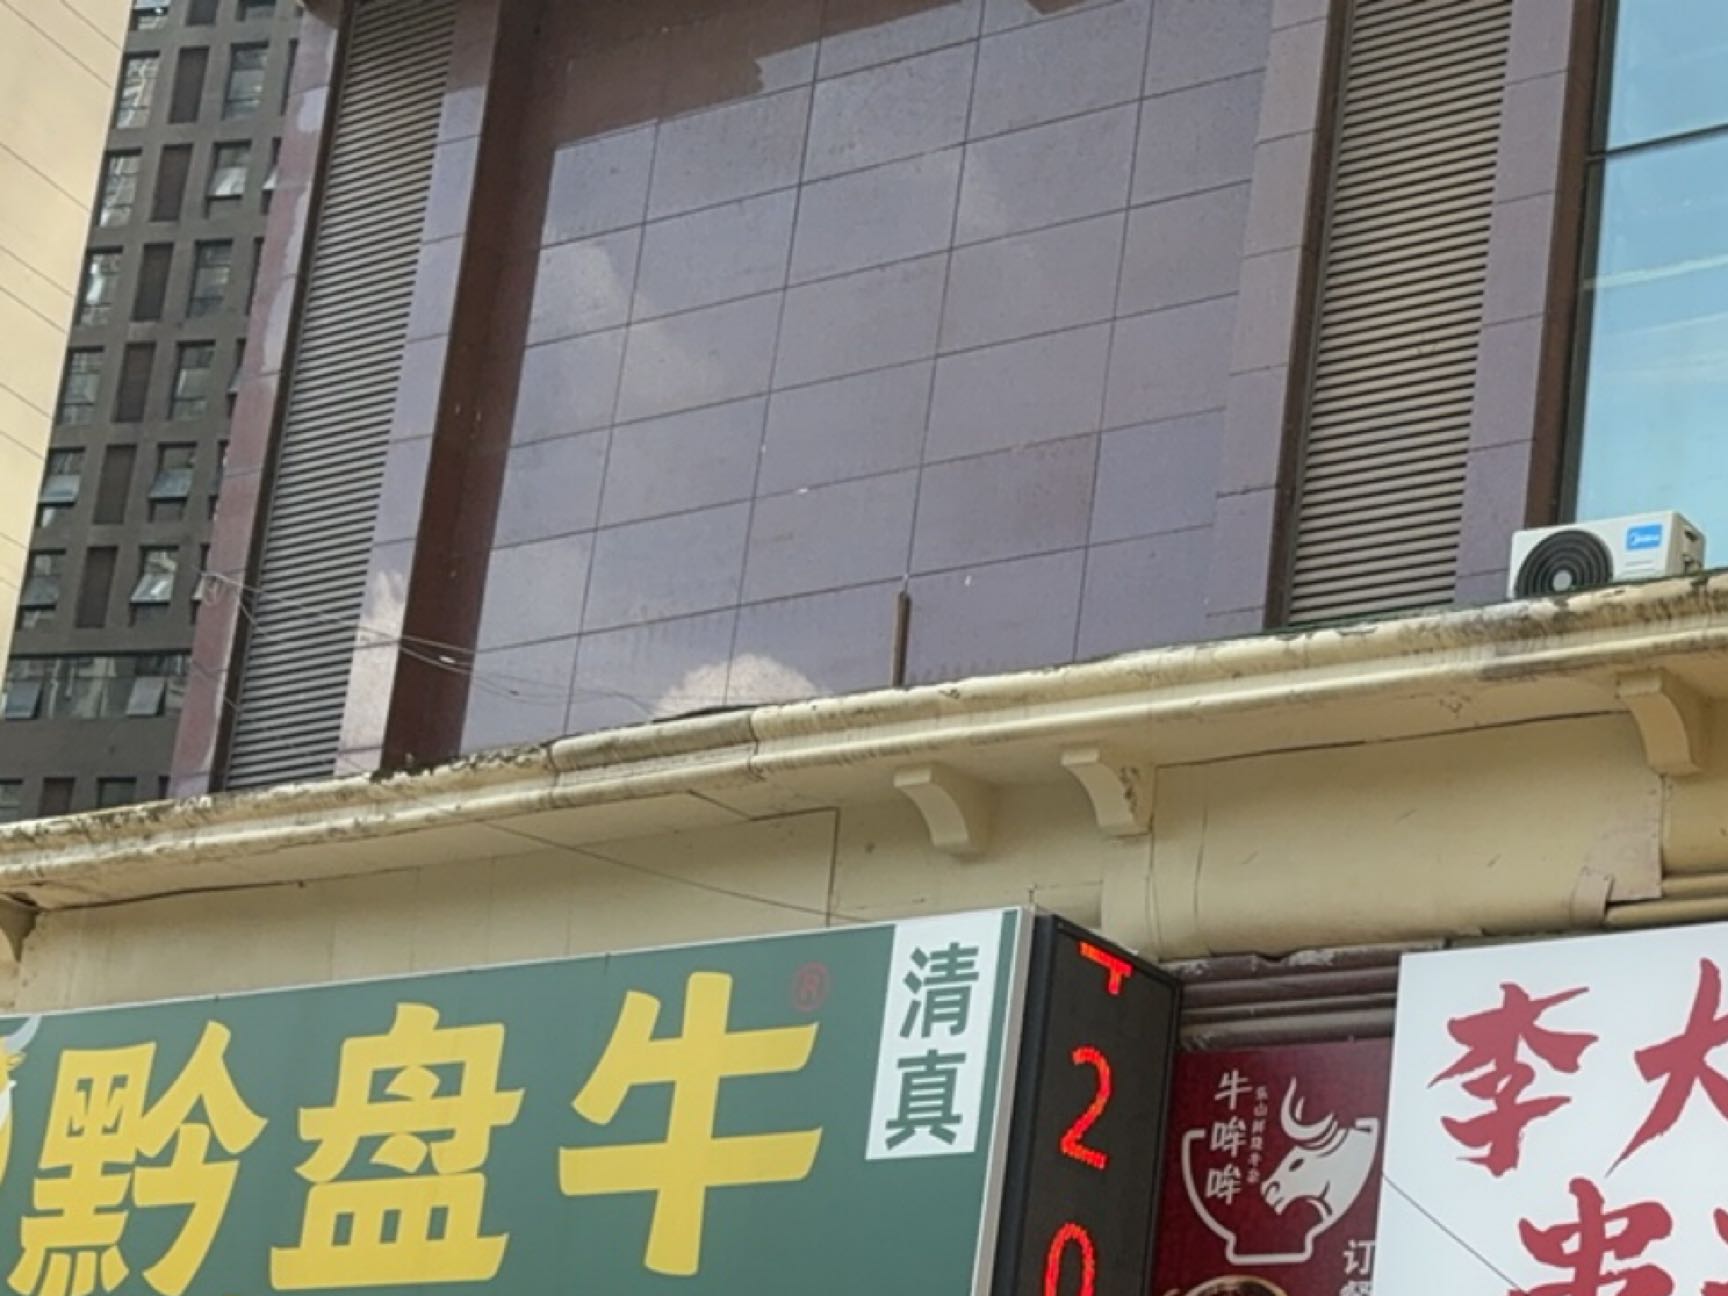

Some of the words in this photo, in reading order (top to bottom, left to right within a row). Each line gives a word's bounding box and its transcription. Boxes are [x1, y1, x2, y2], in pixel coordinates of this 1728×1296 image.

[886, 941, 980, 1150] 清真
[1205, 1069, 1252, 1205] 牛哞哞
